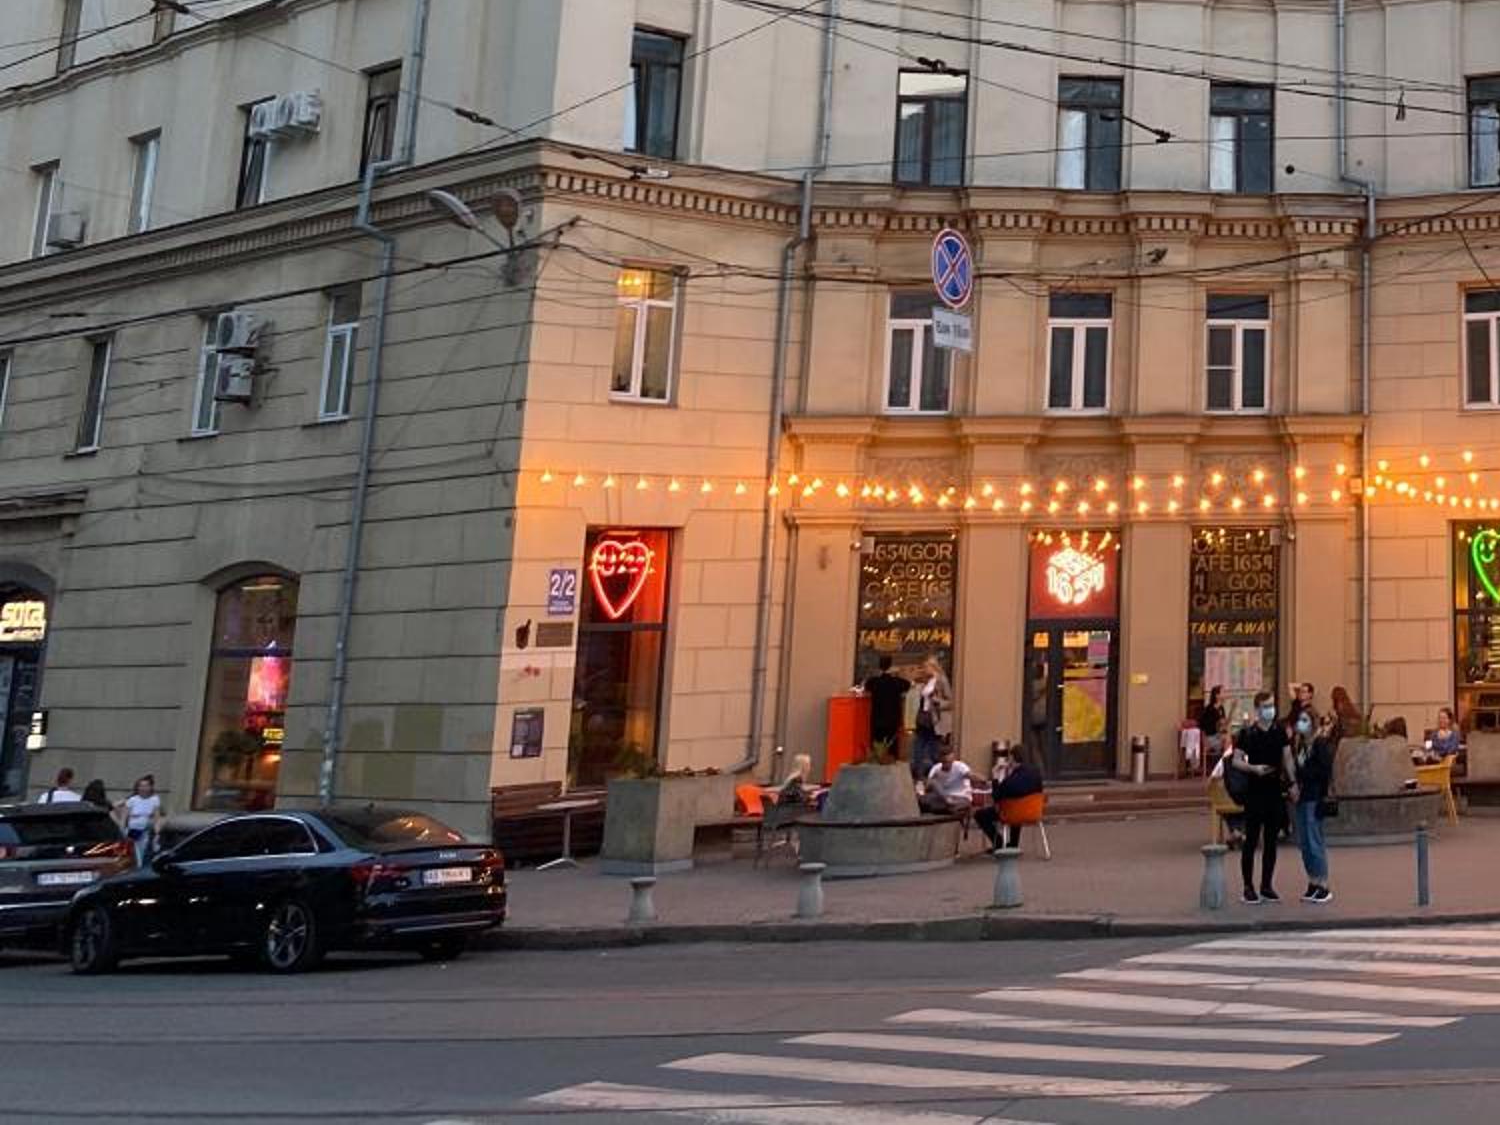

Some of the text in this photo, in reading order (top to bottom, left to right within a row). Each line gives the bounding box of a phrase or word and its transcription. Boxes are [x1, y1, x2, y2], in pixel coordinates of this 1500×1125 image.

[551, 573, 576, 596] 2/2
[1046, 562, 1105, 605] 1654
[1190, 619, 1276, 635] TAKE AWAY
[859, 630, 897, 647] TAKE
